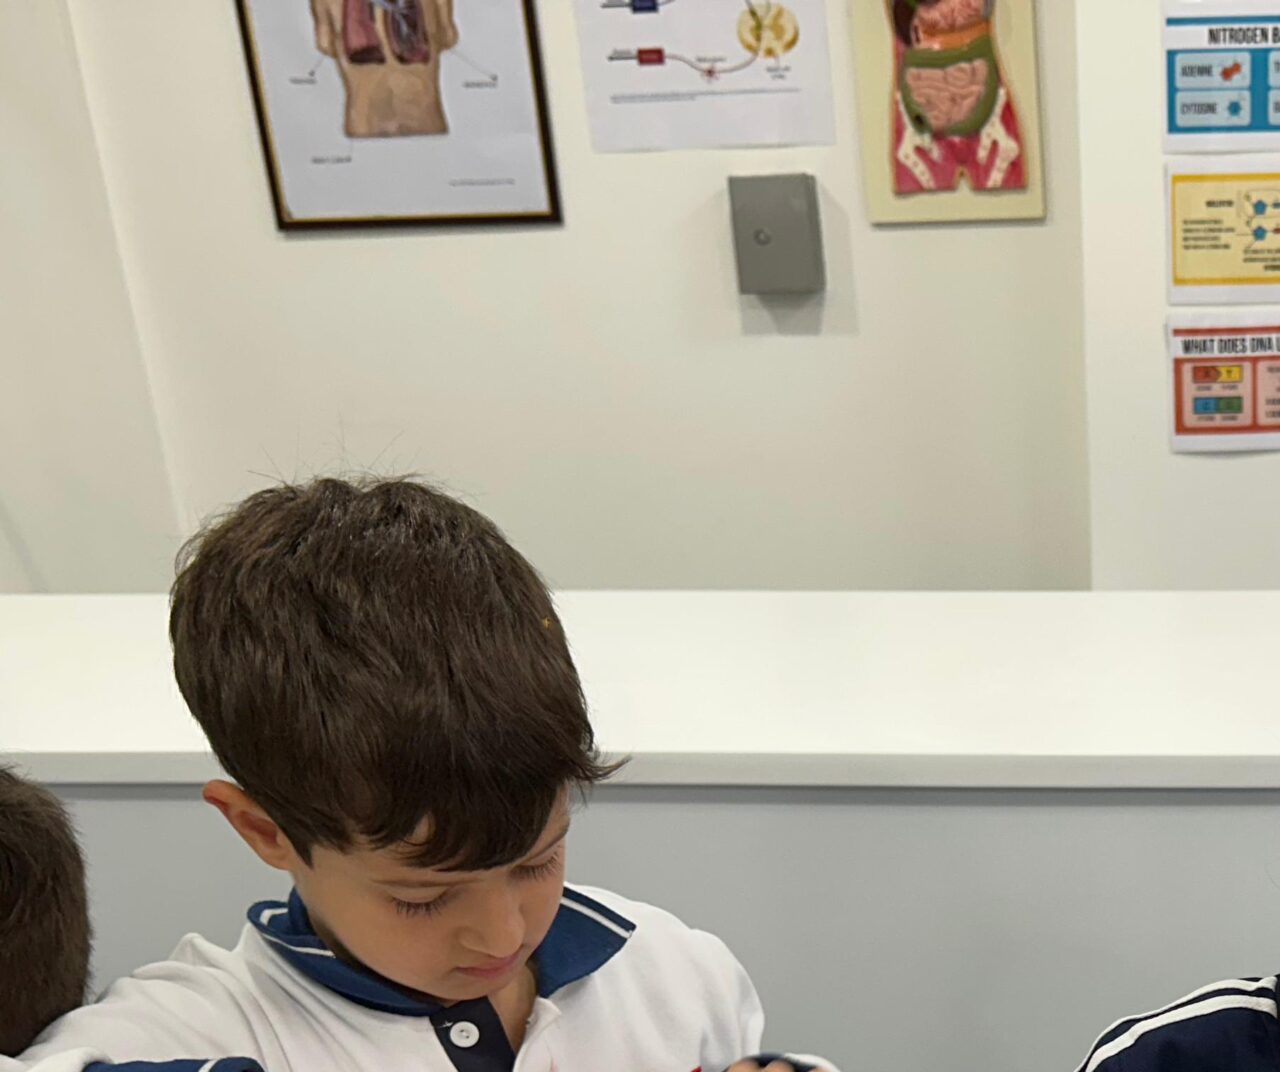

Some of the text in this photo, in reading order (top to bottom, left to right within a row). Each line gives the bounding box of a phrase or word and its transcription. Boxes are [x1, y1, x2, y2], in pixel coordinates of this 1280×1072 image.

[1208, 27, 1269, 45] NITROGEN
[1182, 338, 1215, 354] WHAT
[1217, 337, 1248, 353] DOES
[1250, 336, 1274, 352] DNA
